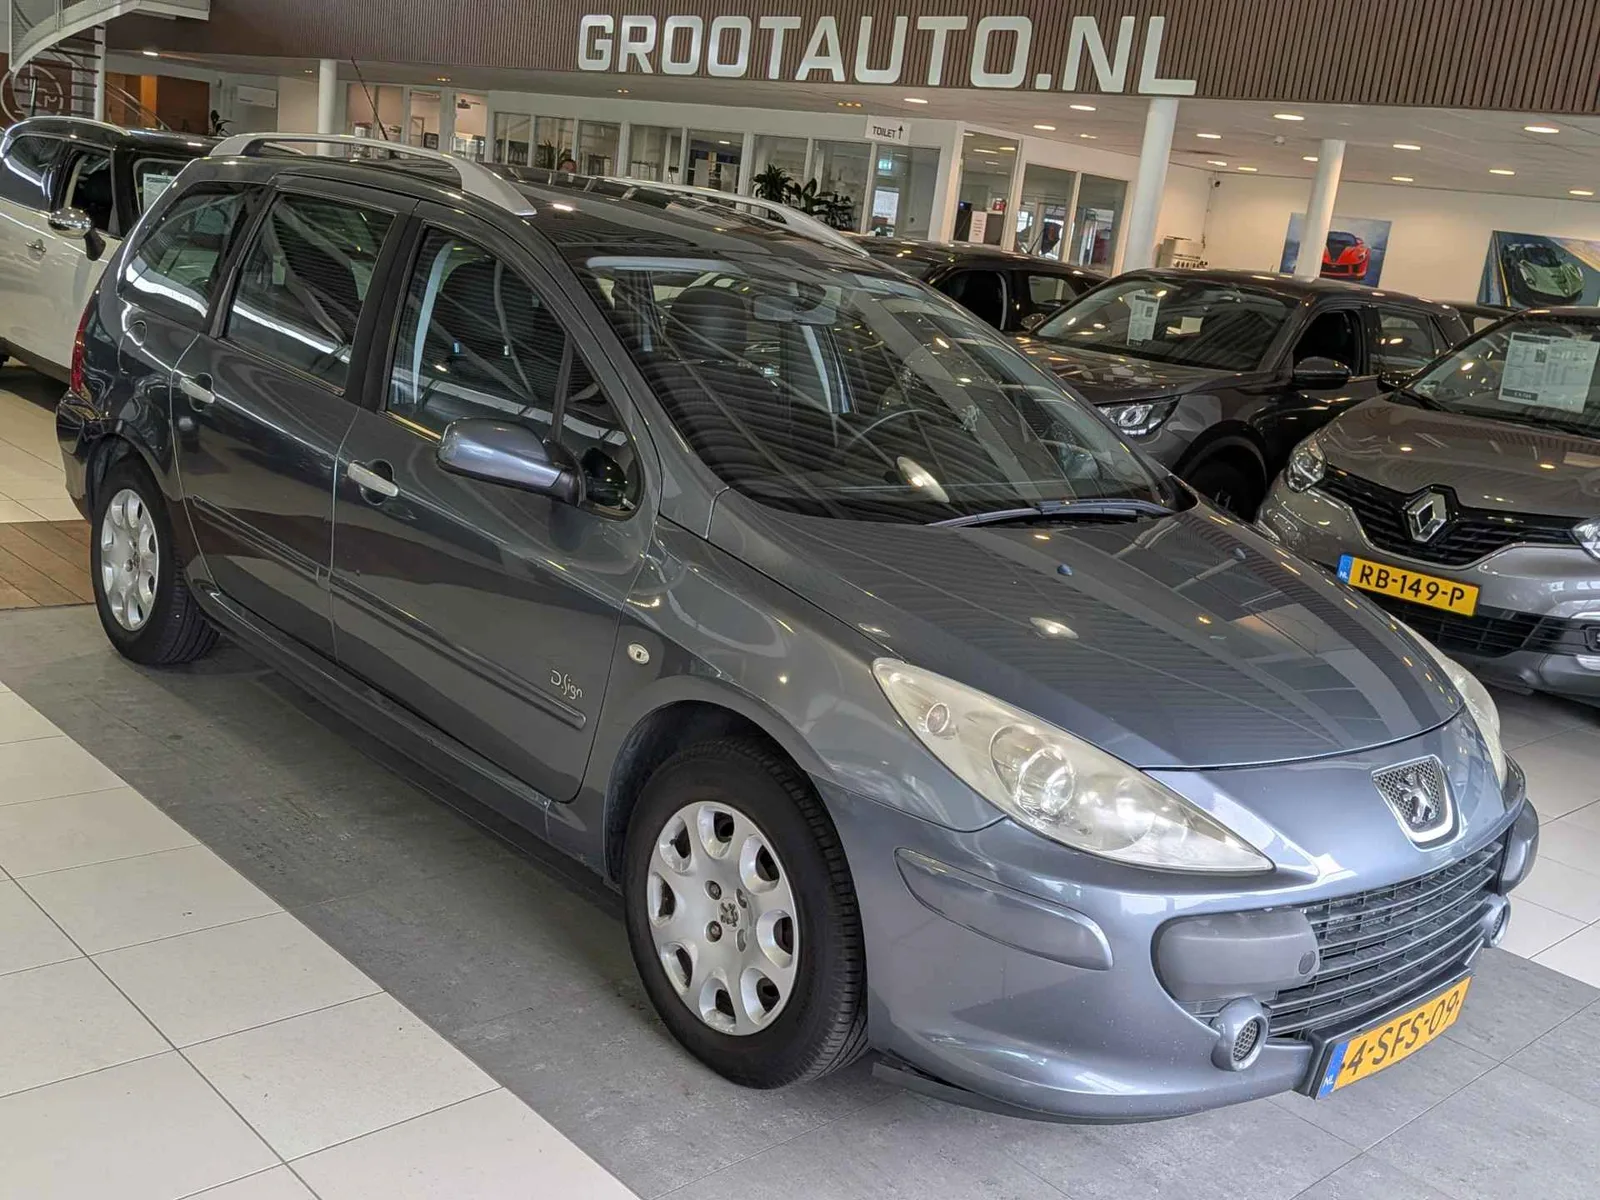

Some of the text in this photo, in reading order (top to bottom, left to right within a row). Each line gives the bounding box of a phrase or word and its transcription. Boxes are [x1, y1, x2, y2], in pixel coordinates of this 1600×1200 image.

[577, 13, 1197, 96] GROOTAUTO.NL
[872, 125, 897, 139] TOILET
[1359, 564, 1465, 607] RB-149-P
[1346, 989, 1460, 1076] 4-SFS-09
[1323, 1074, 1335, 1088] NL
